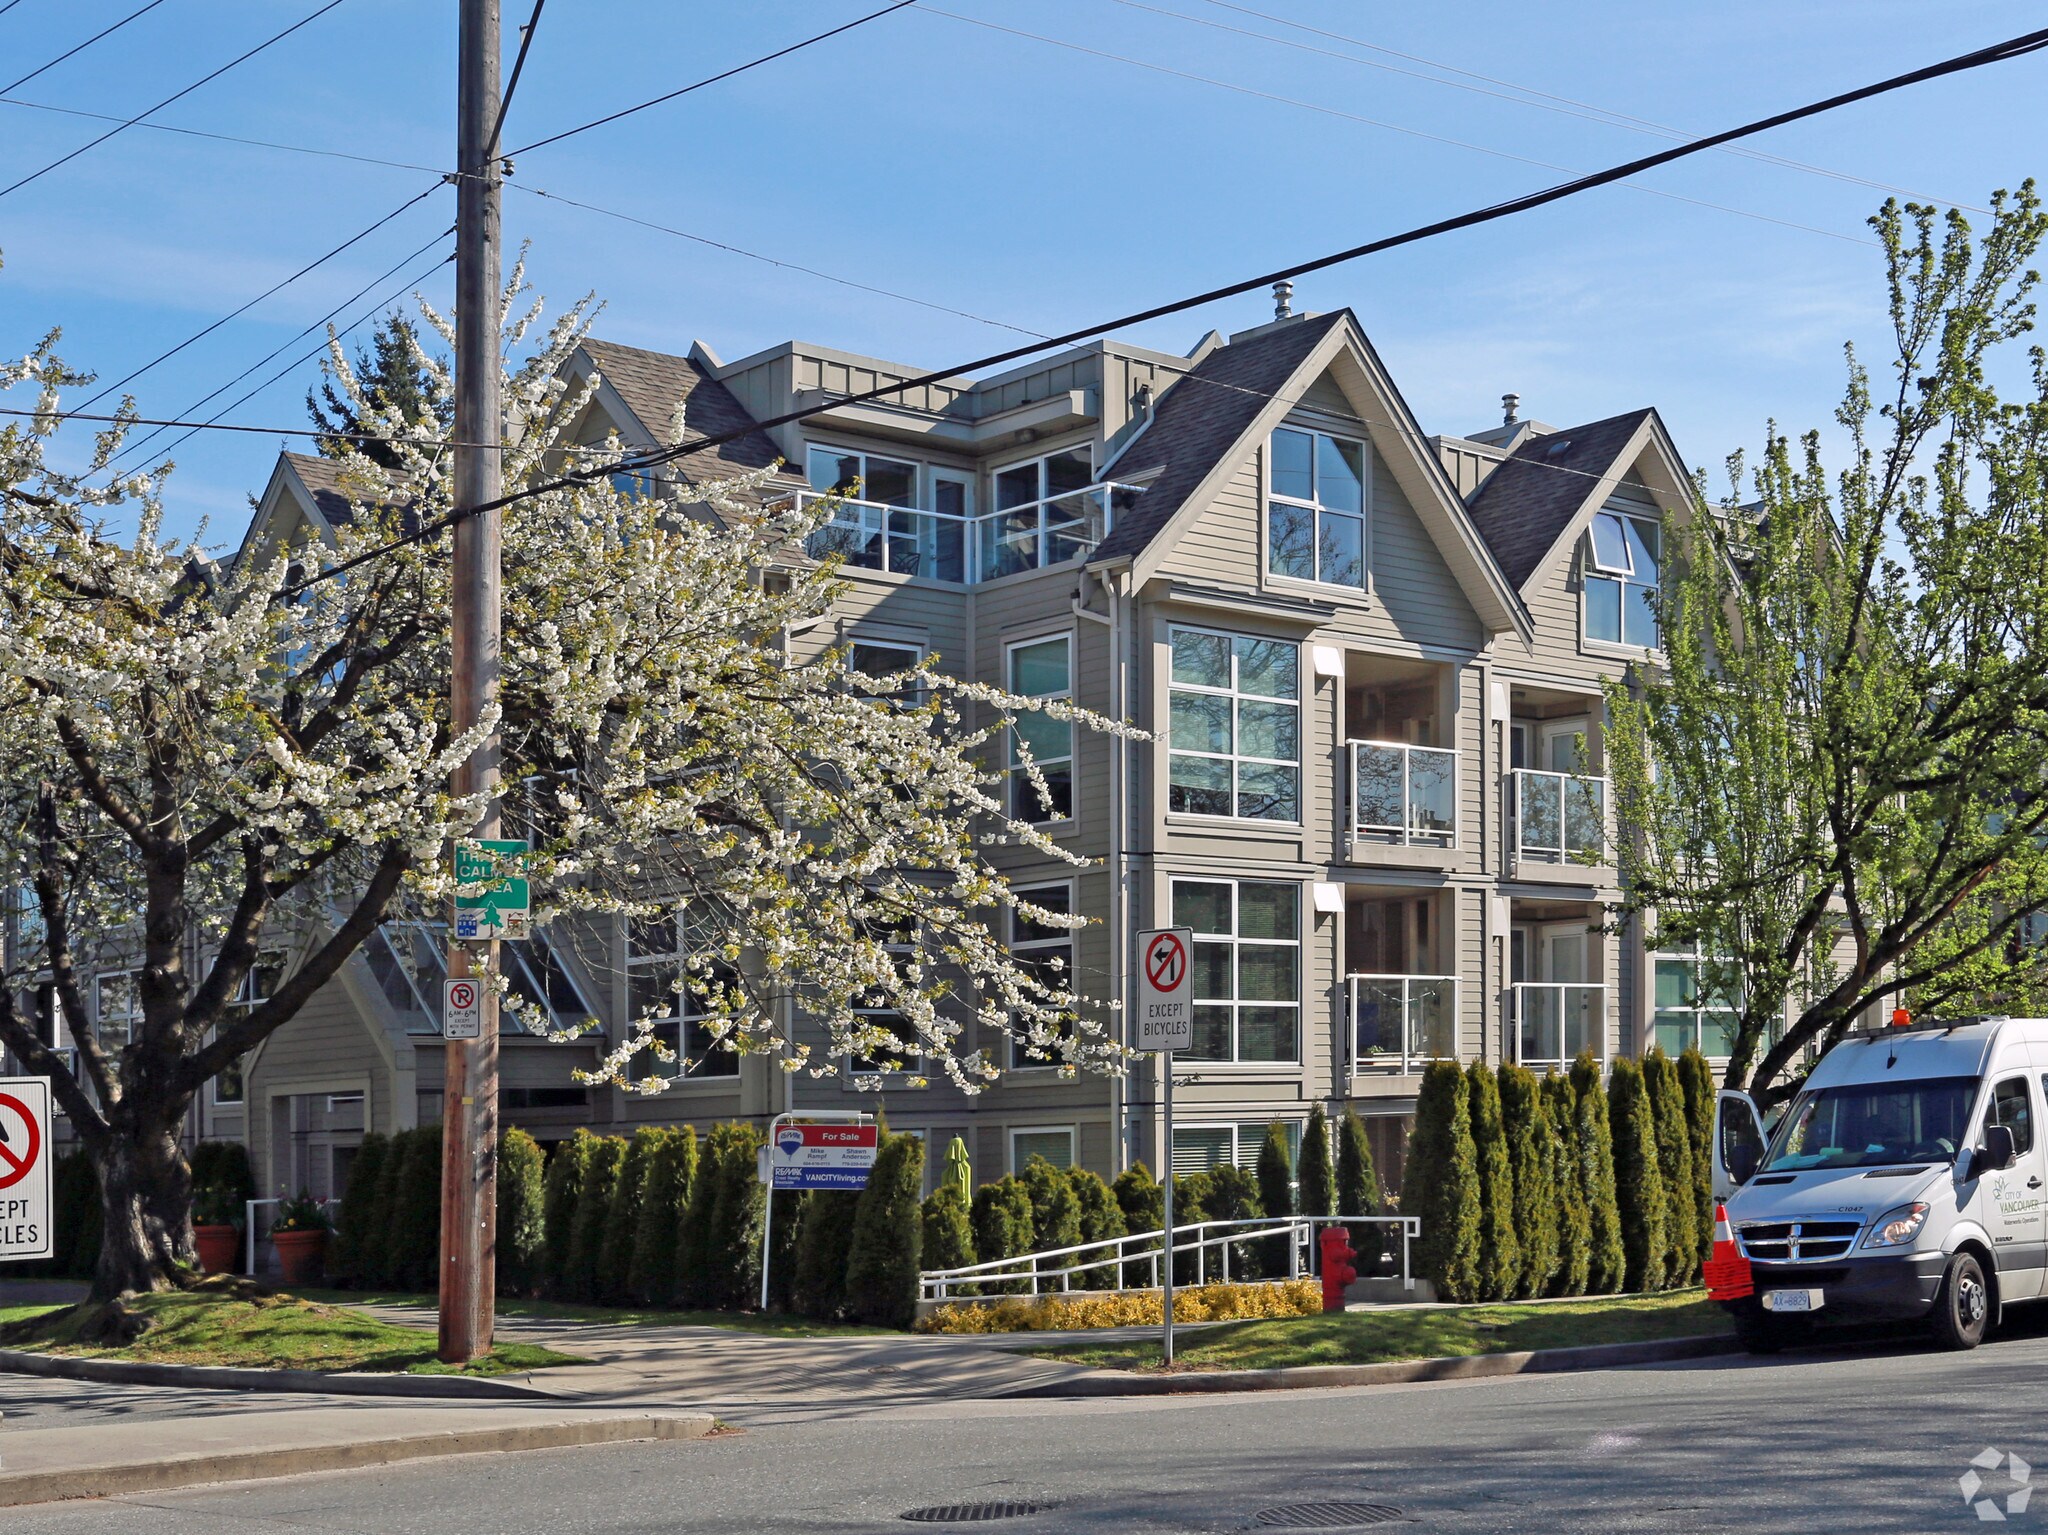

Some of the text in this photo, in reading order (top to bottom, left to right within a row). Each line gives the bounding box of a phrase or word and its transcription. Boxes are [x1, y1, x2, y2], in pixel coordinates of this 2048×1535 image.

[1149, 1003, 1183, 1018] EXCEPT
[1144, 1021, 1187, 1036] BICYCLES
[822, 1132, 860, 1141] For Sale
[775, 1167, 803, 1176] RE/MAX
[2005, 1190, 2022, 1200] CITY OF
[2000, 1199, 2040, 1213] VANCOUVER
